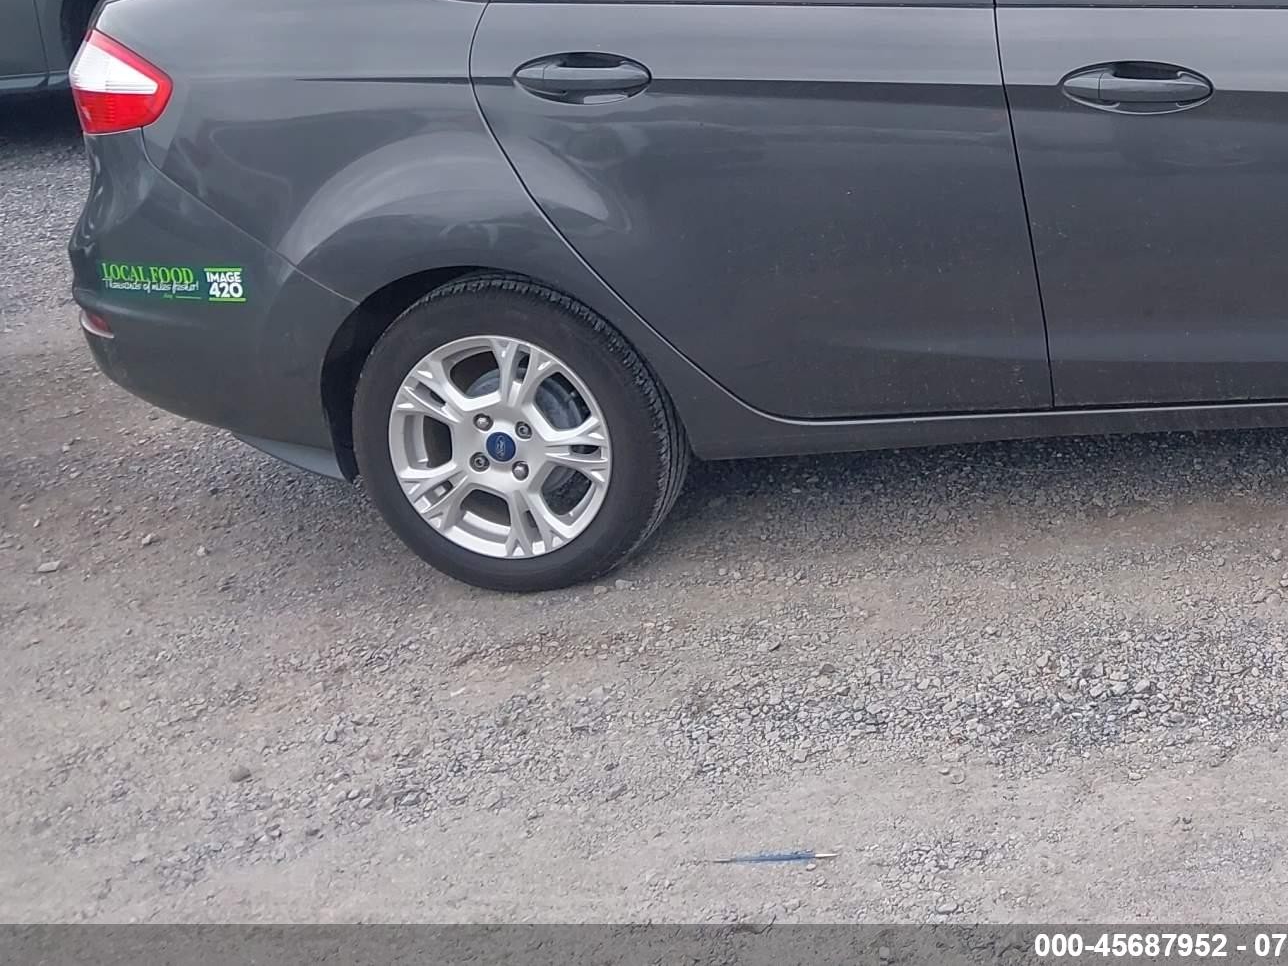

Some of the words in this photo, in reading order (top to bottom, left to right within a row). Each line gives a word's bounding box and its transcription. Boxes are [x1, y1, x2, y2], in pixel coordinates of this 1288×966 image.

[102, 263, 148, 284] LOCAL
[149, 267, 194, 284] FOOD
[205, 271, 242, 283] IMAGE
[208, 282, 244, 298] 420
